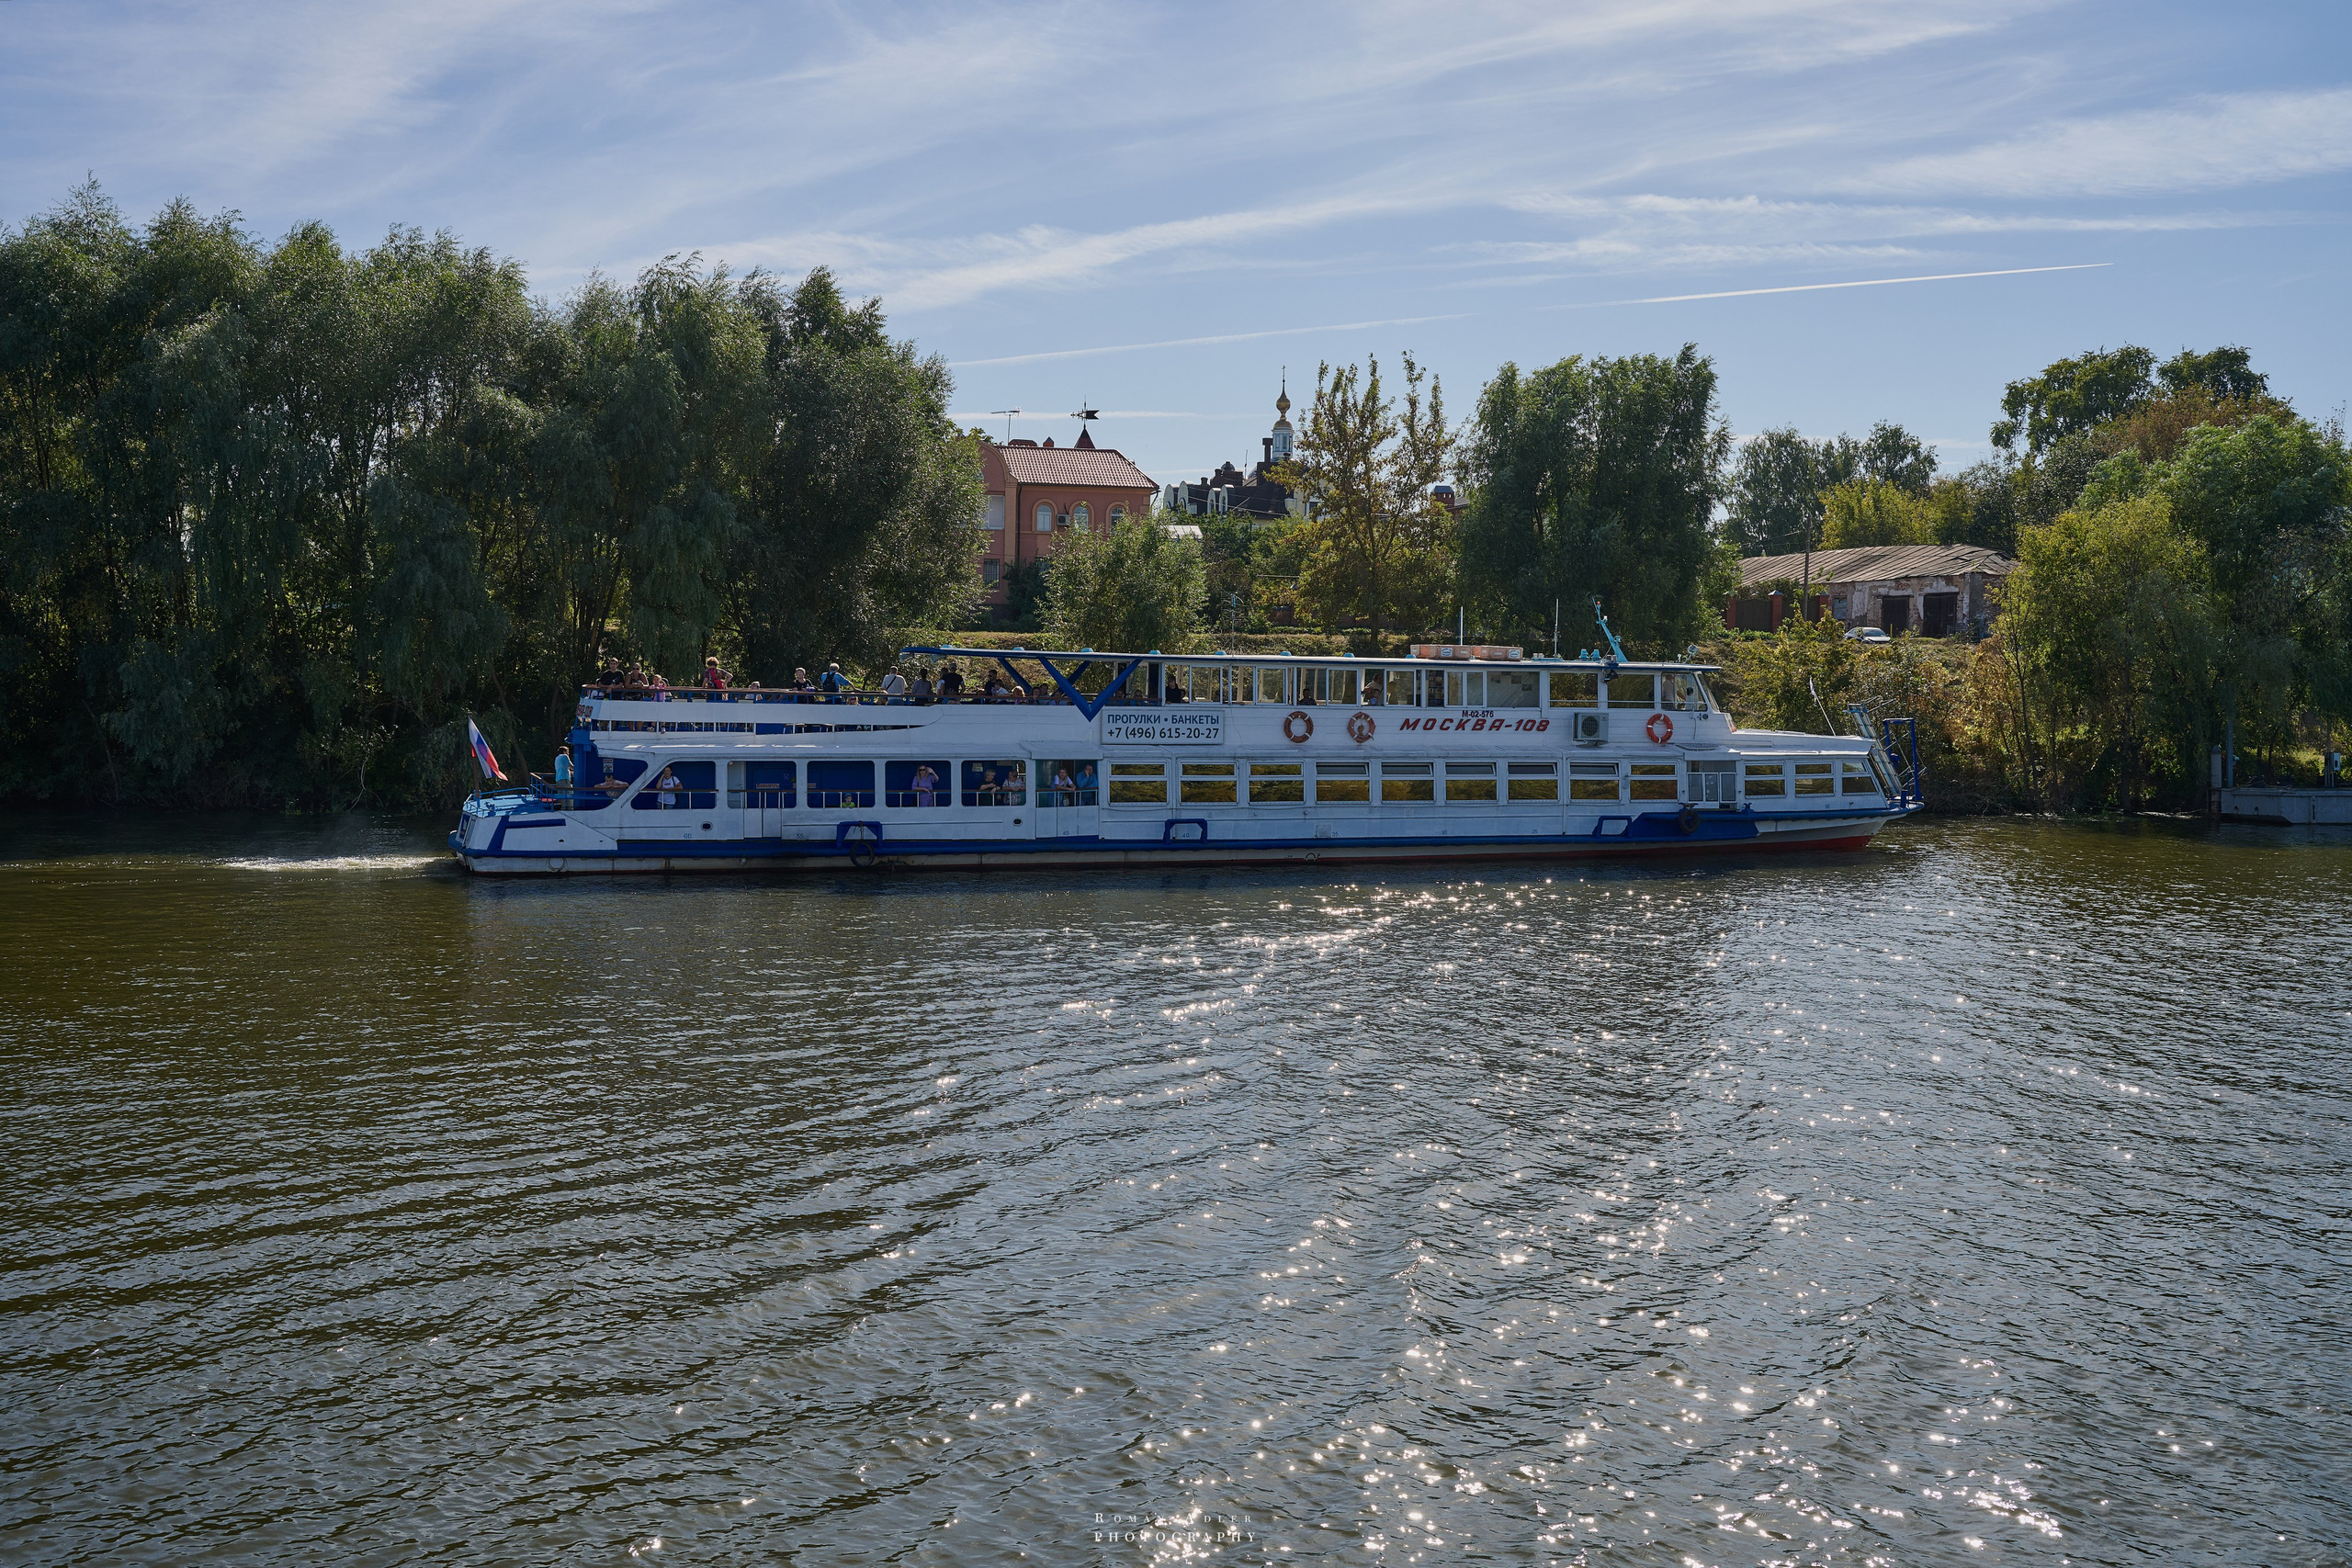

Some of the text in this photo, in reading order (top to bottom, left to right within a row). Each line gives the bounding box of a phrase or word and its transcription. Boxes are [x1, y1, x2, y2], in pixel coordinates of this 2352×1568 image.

[1107, 714, 1219, 725] ПРОГУЛКИ БАНКЕТЫ
[1399, 717, 1550, 731] МОСКВА-108
[1108, 726, 1219, 739] +7 (496) 615-20-27
